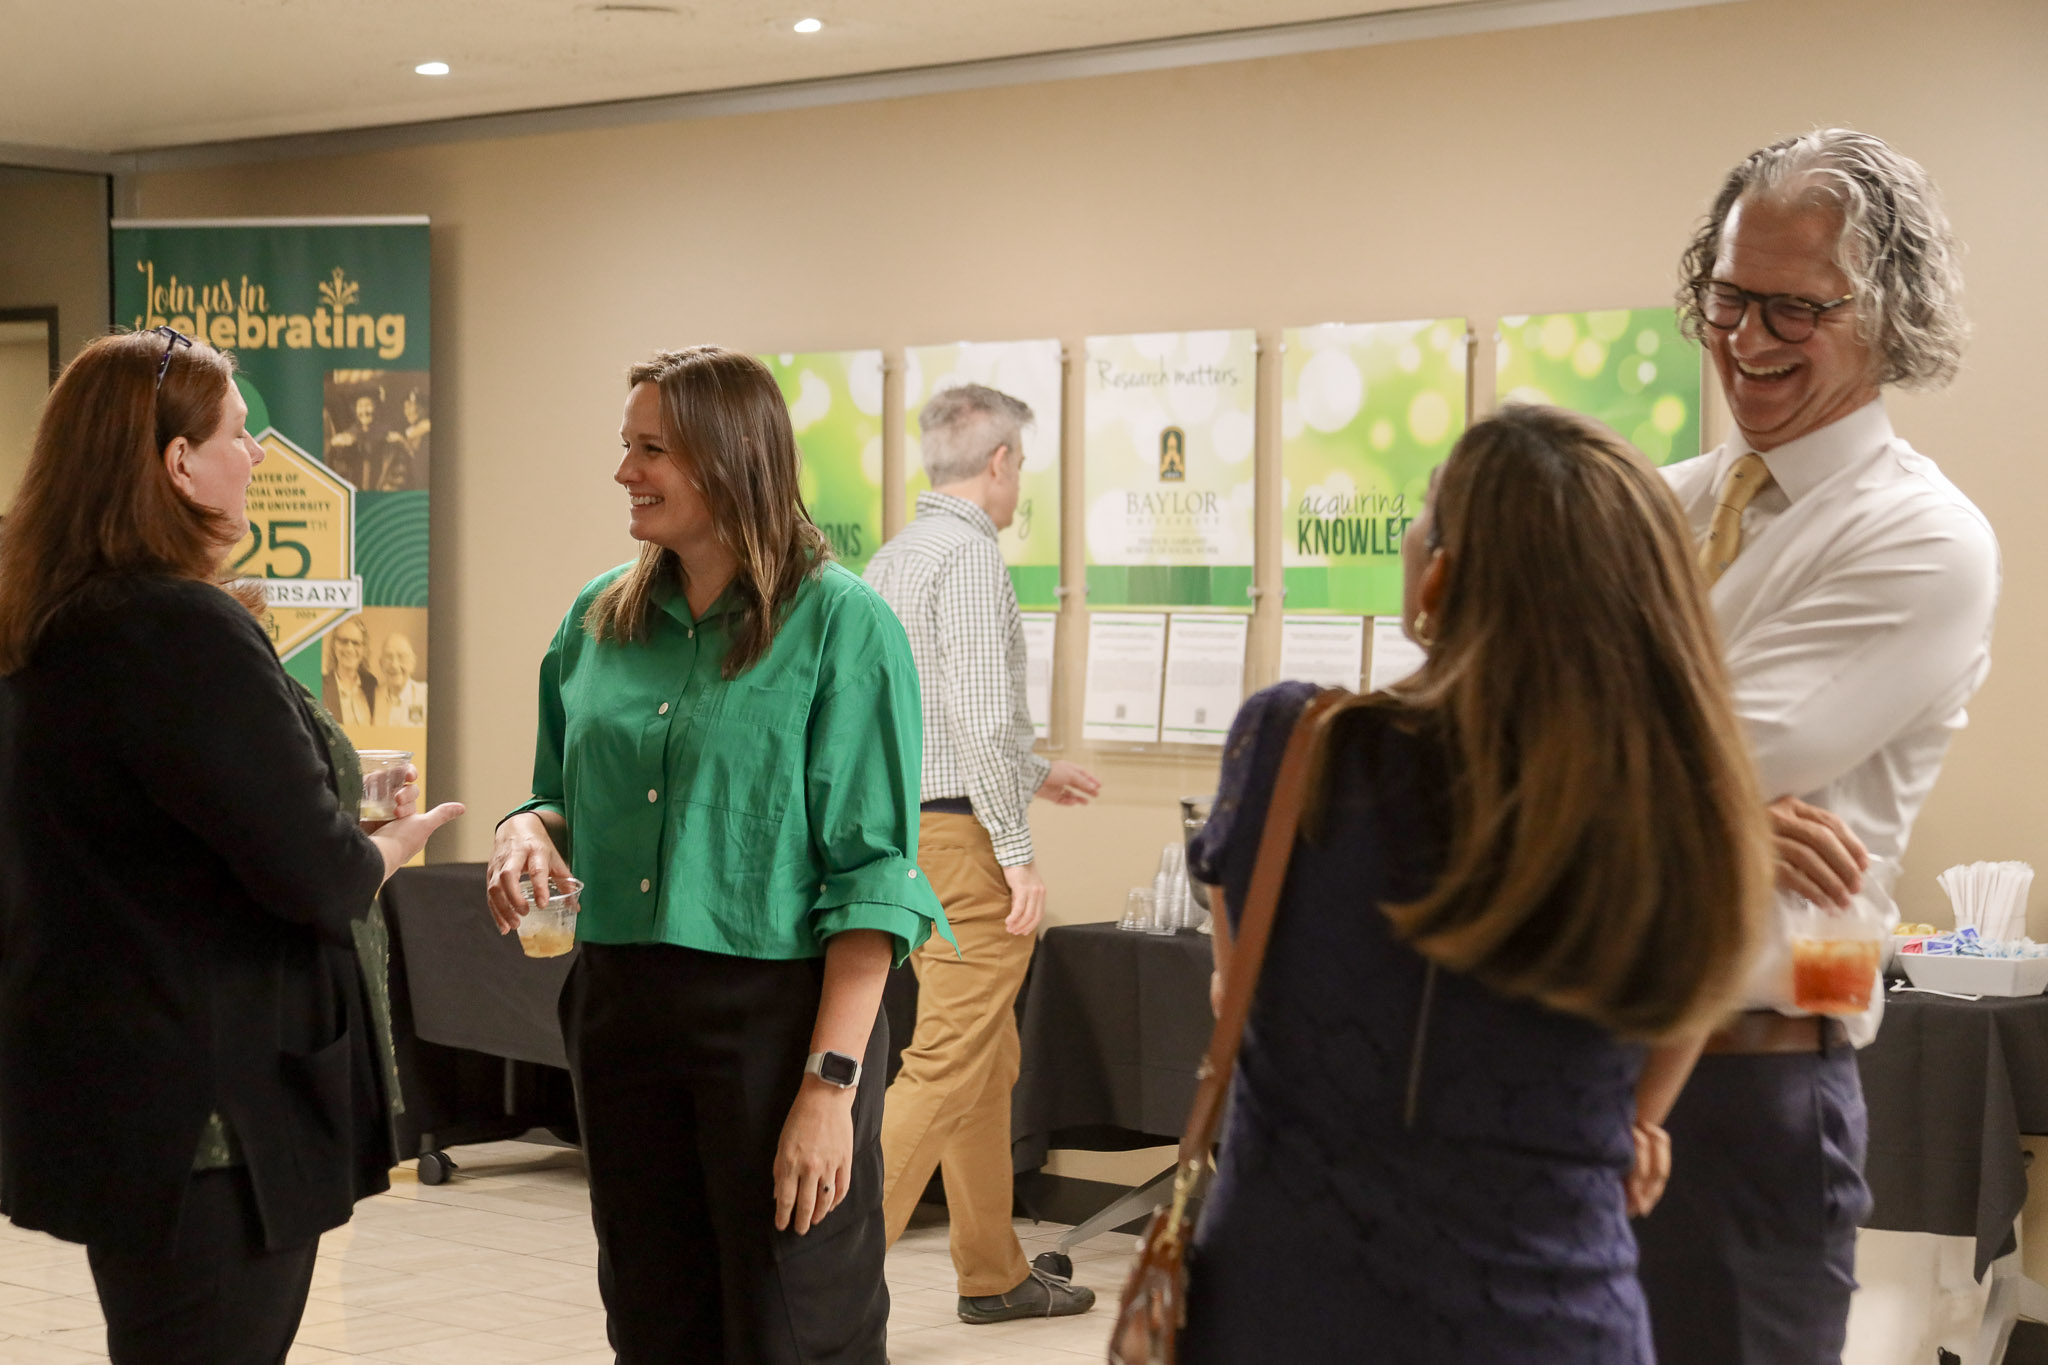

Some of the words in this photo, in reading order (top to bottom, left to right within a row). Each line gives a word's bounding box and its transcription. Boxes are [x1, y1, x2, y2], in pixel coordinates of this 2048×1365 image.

[137, 260, 195, 331] Join
[202, 278, 234, 313] us
[240, 274, 268, 313] in
[1096, 353, 1169, 391] Research
[246, 487, 271, 497] CIAL
[275, 487, 306, 497] WORK
[251, 473, 282, 483] ASTER
[285, 473, 299, 483] OF
[268, 501, 331, 511] UNIVERSITY
[1127, 490, 1220, 514] BAYLOR
[1299, 484, 1405, 540] acquiring
[1297, 517, 1412, 556] KNOWLE
